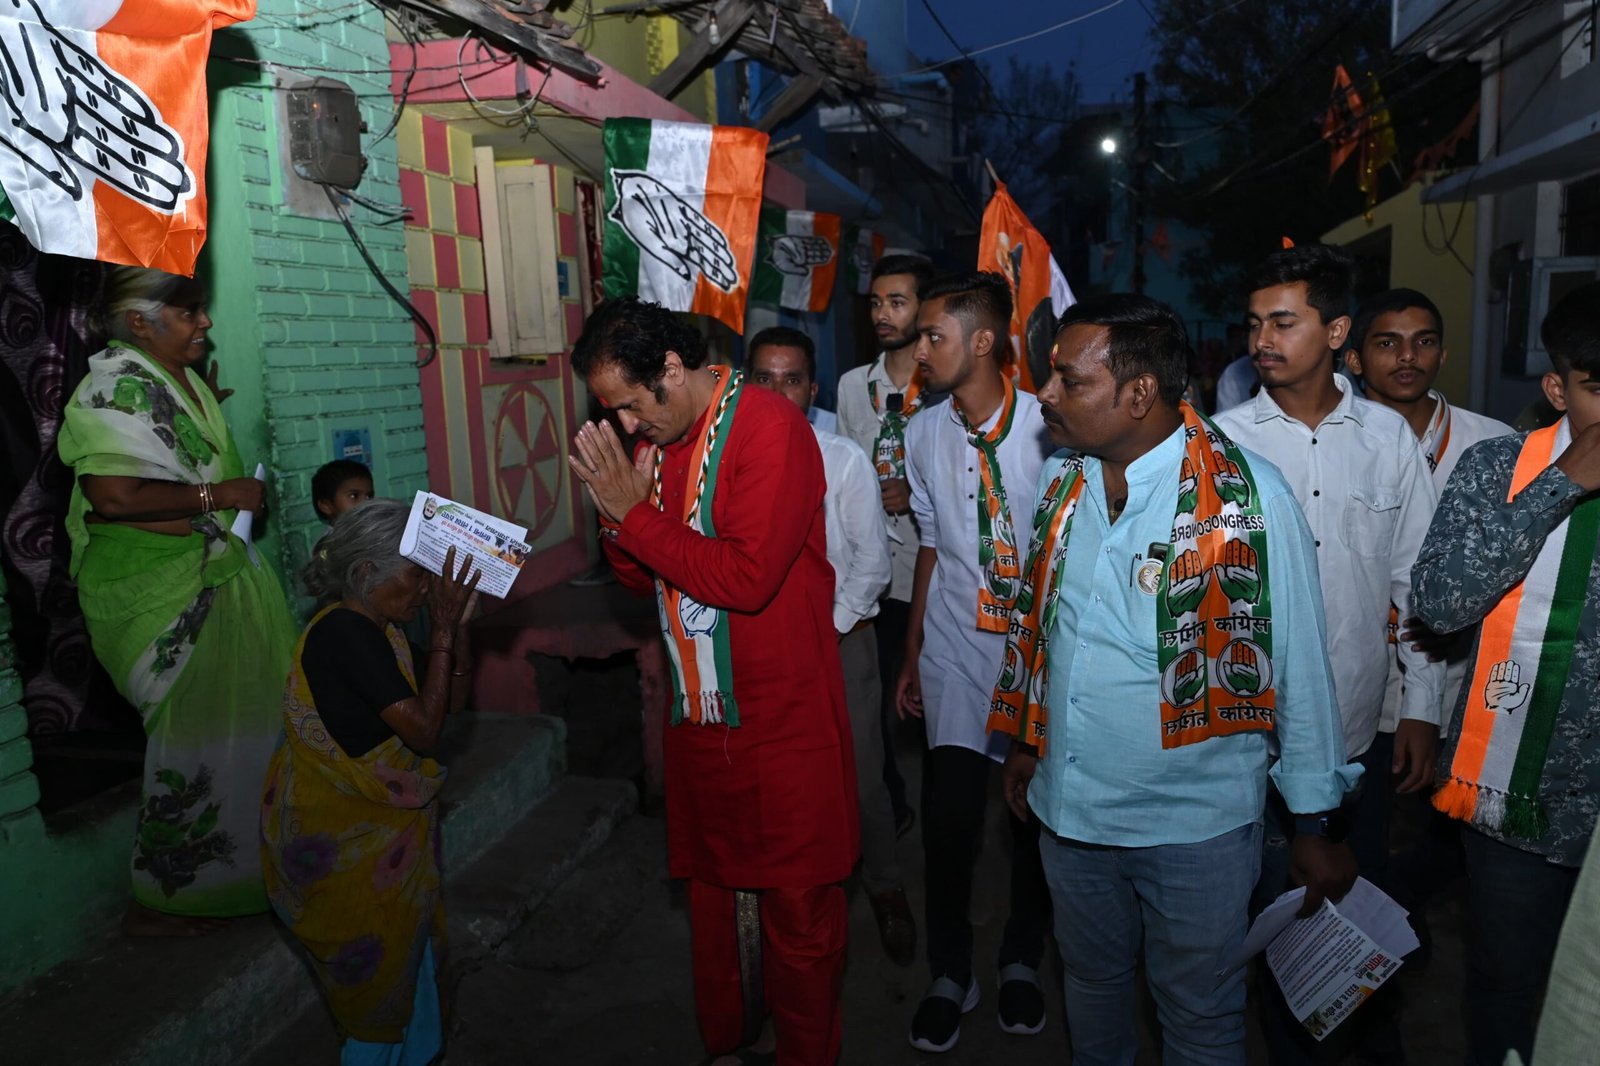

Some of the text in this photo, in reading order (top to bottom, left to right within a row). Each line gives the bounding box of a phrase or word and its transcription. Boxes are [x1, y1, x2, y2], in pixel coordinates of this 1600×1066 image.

[1210, 514, 1265, 531] ONGRESS
[1214, 611, 1271, 634] कांग्रेस
[1217, 701, 1275, 724] कांग्रेस
